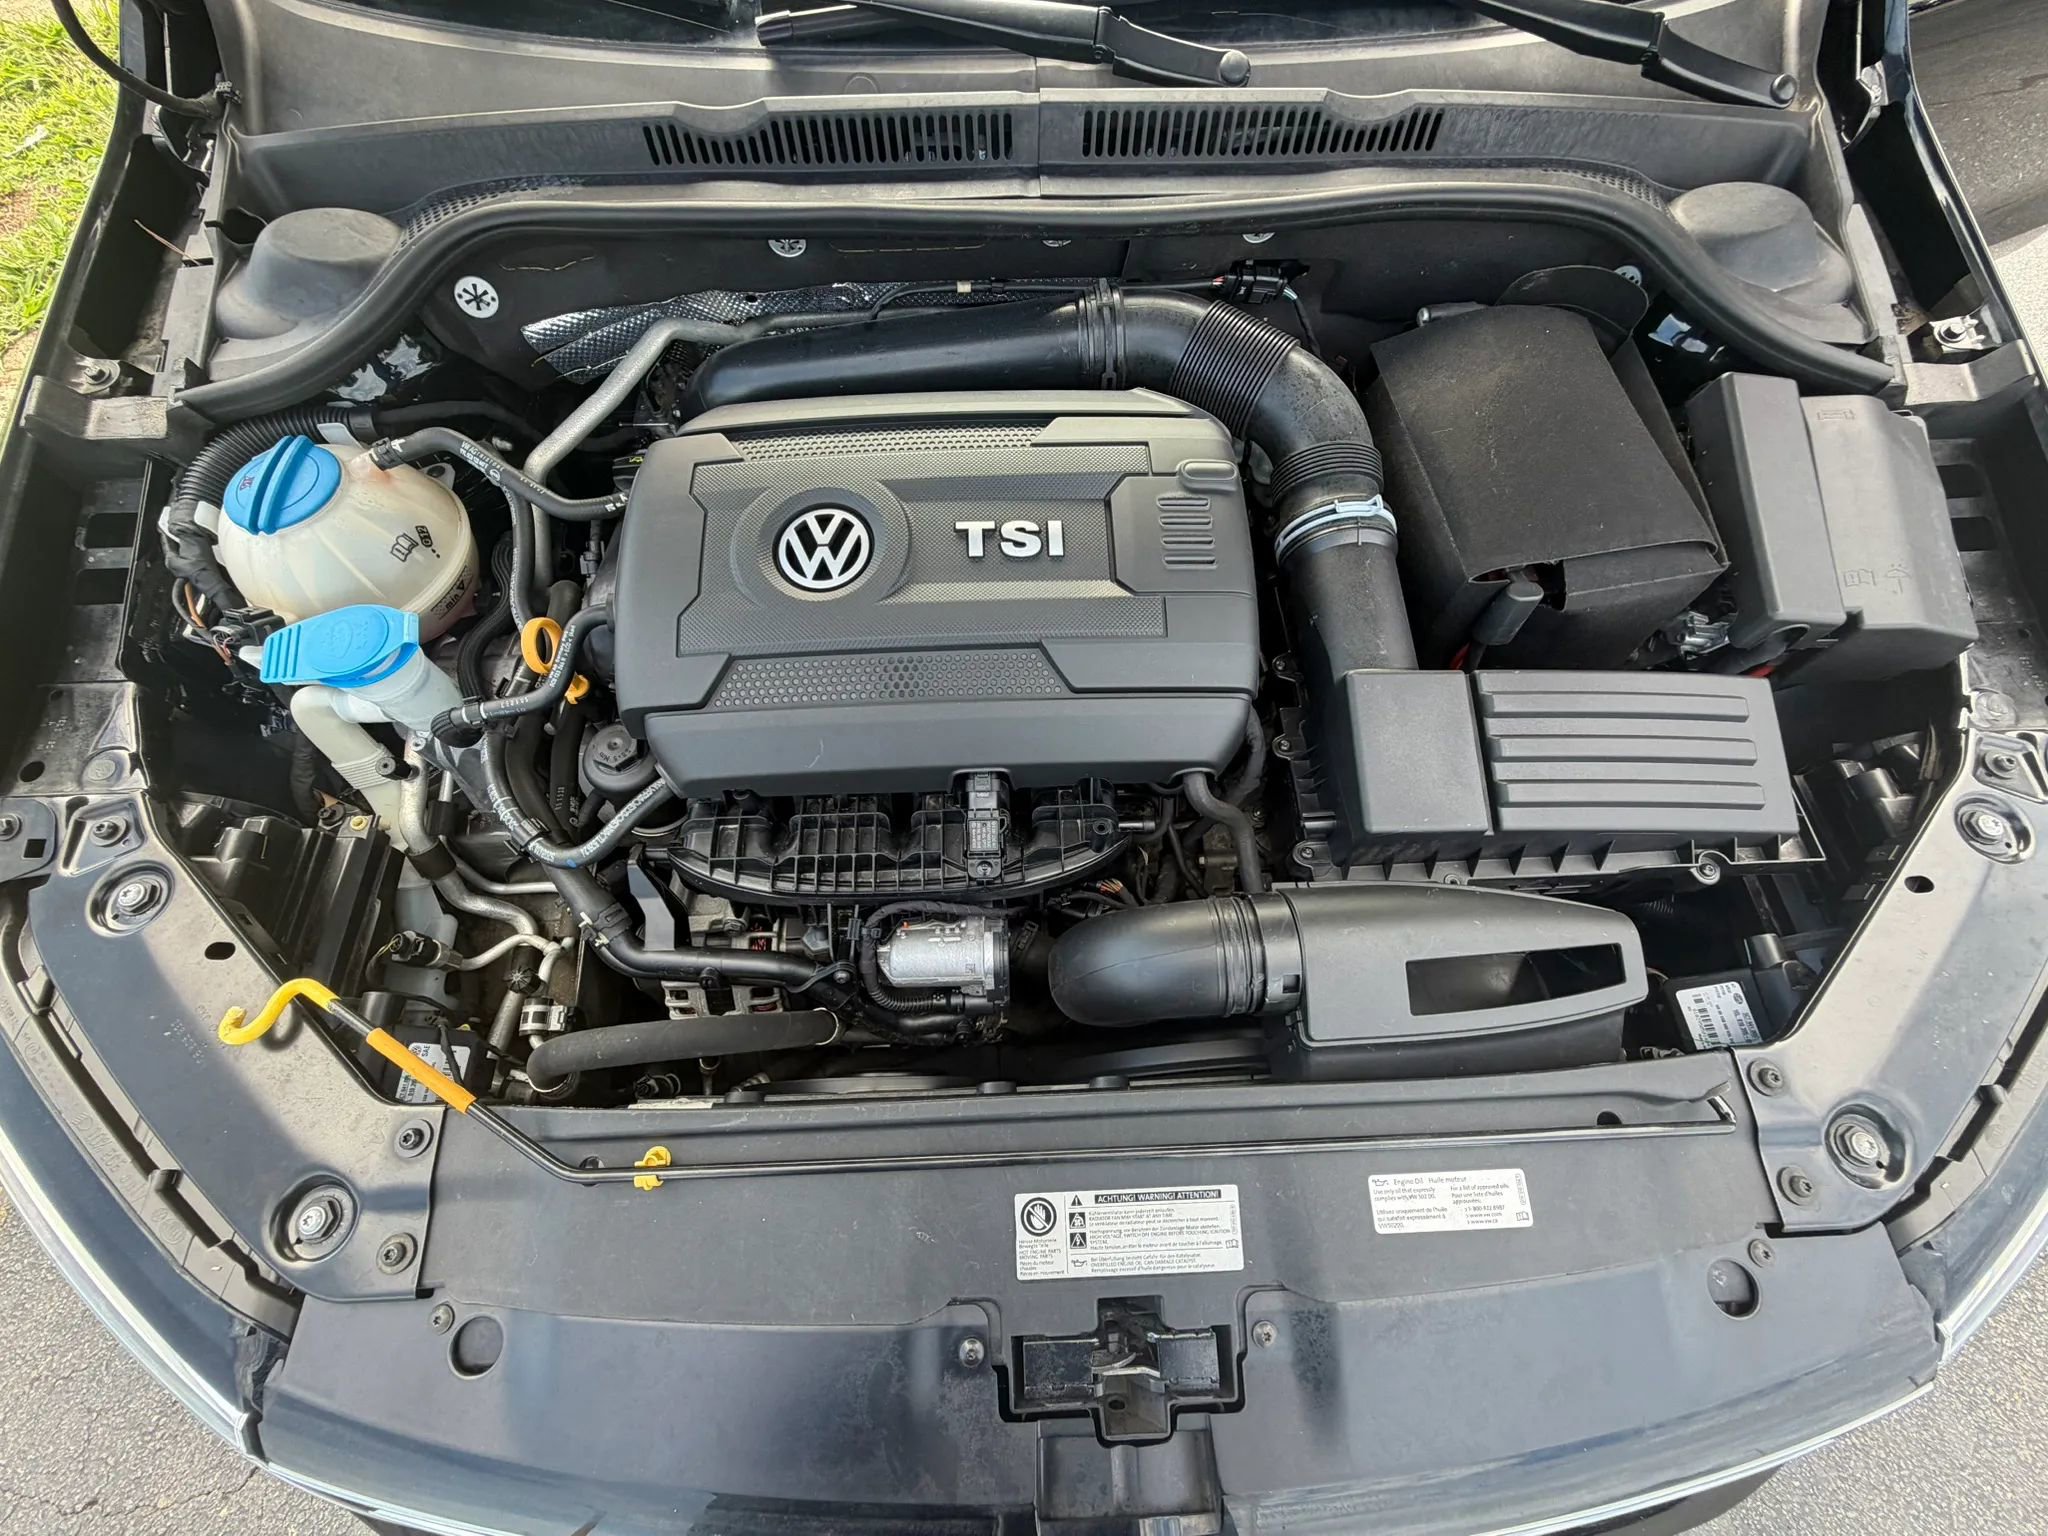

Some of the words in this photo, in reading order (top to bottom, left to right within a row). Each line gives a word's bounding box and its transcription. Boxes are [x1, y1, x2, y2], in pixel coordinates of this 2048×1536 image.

[954, 519, 1066, 559] TSI
[445, 593, 460, 610] min
[1393, 1179, 1414, 1187] Engine
[1097, 1195, 1136, 1203] ACHTUNG!
[1137, 1192, 1176, 1201] WARNING!
[1177, 1190, 1220, 1199] ATTENTION!
